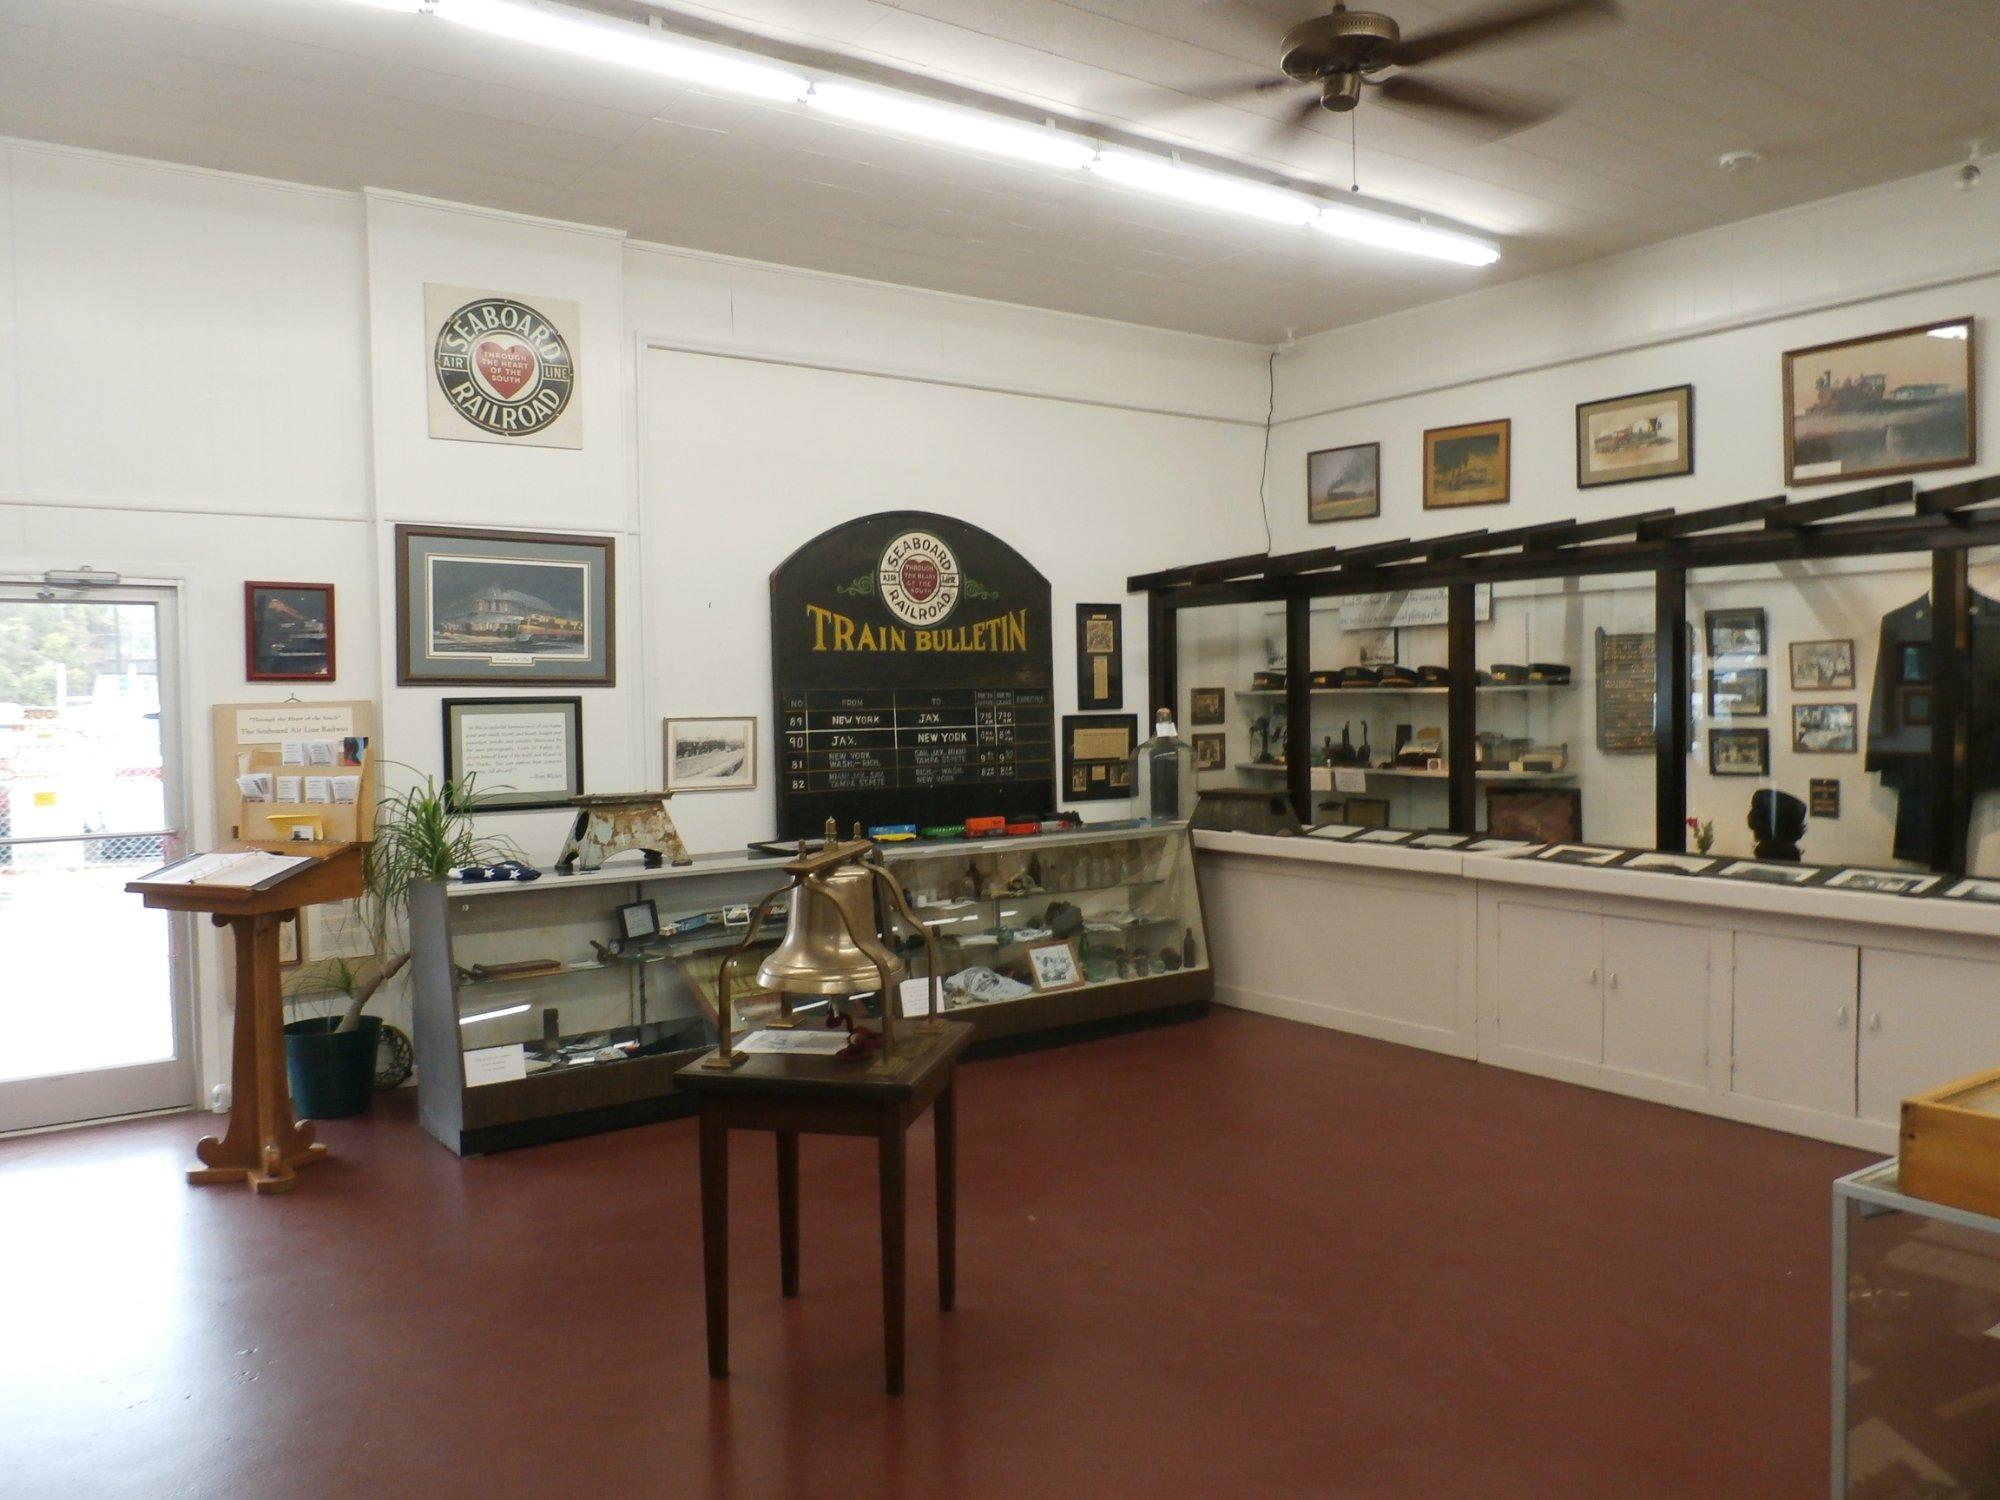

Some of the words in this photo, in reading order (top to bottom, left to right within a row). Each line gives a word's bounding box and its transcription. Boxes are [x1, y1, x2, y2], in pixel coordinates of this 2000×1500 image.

[446, 306, 561, 360] SEABOARD
[484, 351, 527, 362] THROUGH
[443, 357, 464, 369] AIR
[481, 358, 499, 367] THE
[501, 360, 528, 369] HEART
[490, 366, 503, 375] OF
[505, 368, 522, 377] THE
[545, 367, 568, 380] LINE
[491, 374, 521, 384] SOUTH
[451, 381, 561, 430] RAILROAD
[887, 537, 952, 571] SEABOARD
[888, 589, 952, 620] RAILROAD
[806, 602, 908, 653] TRAIN
[914, 607, 1028, 653] BULLETIN
[842, 699, 864, 707] FROM
[789, 717, 803, 726] 89
[832, 716, 852, 725] NEW
[855, 715, 880, 724] YORK
[789, 736, 804, 749] 90
[831, 736, 857, 747] JAX.
[917, 733, 939, 743] NEW
[941, 731, 968, 742] YORK
[828, 753, 847, 761] NEW
[850, 751, 871, 760] YORK
[791, 760, 803, 770] 81
[792, 779, 806, 790] 82
[916, 775, 933, 784] NEW
